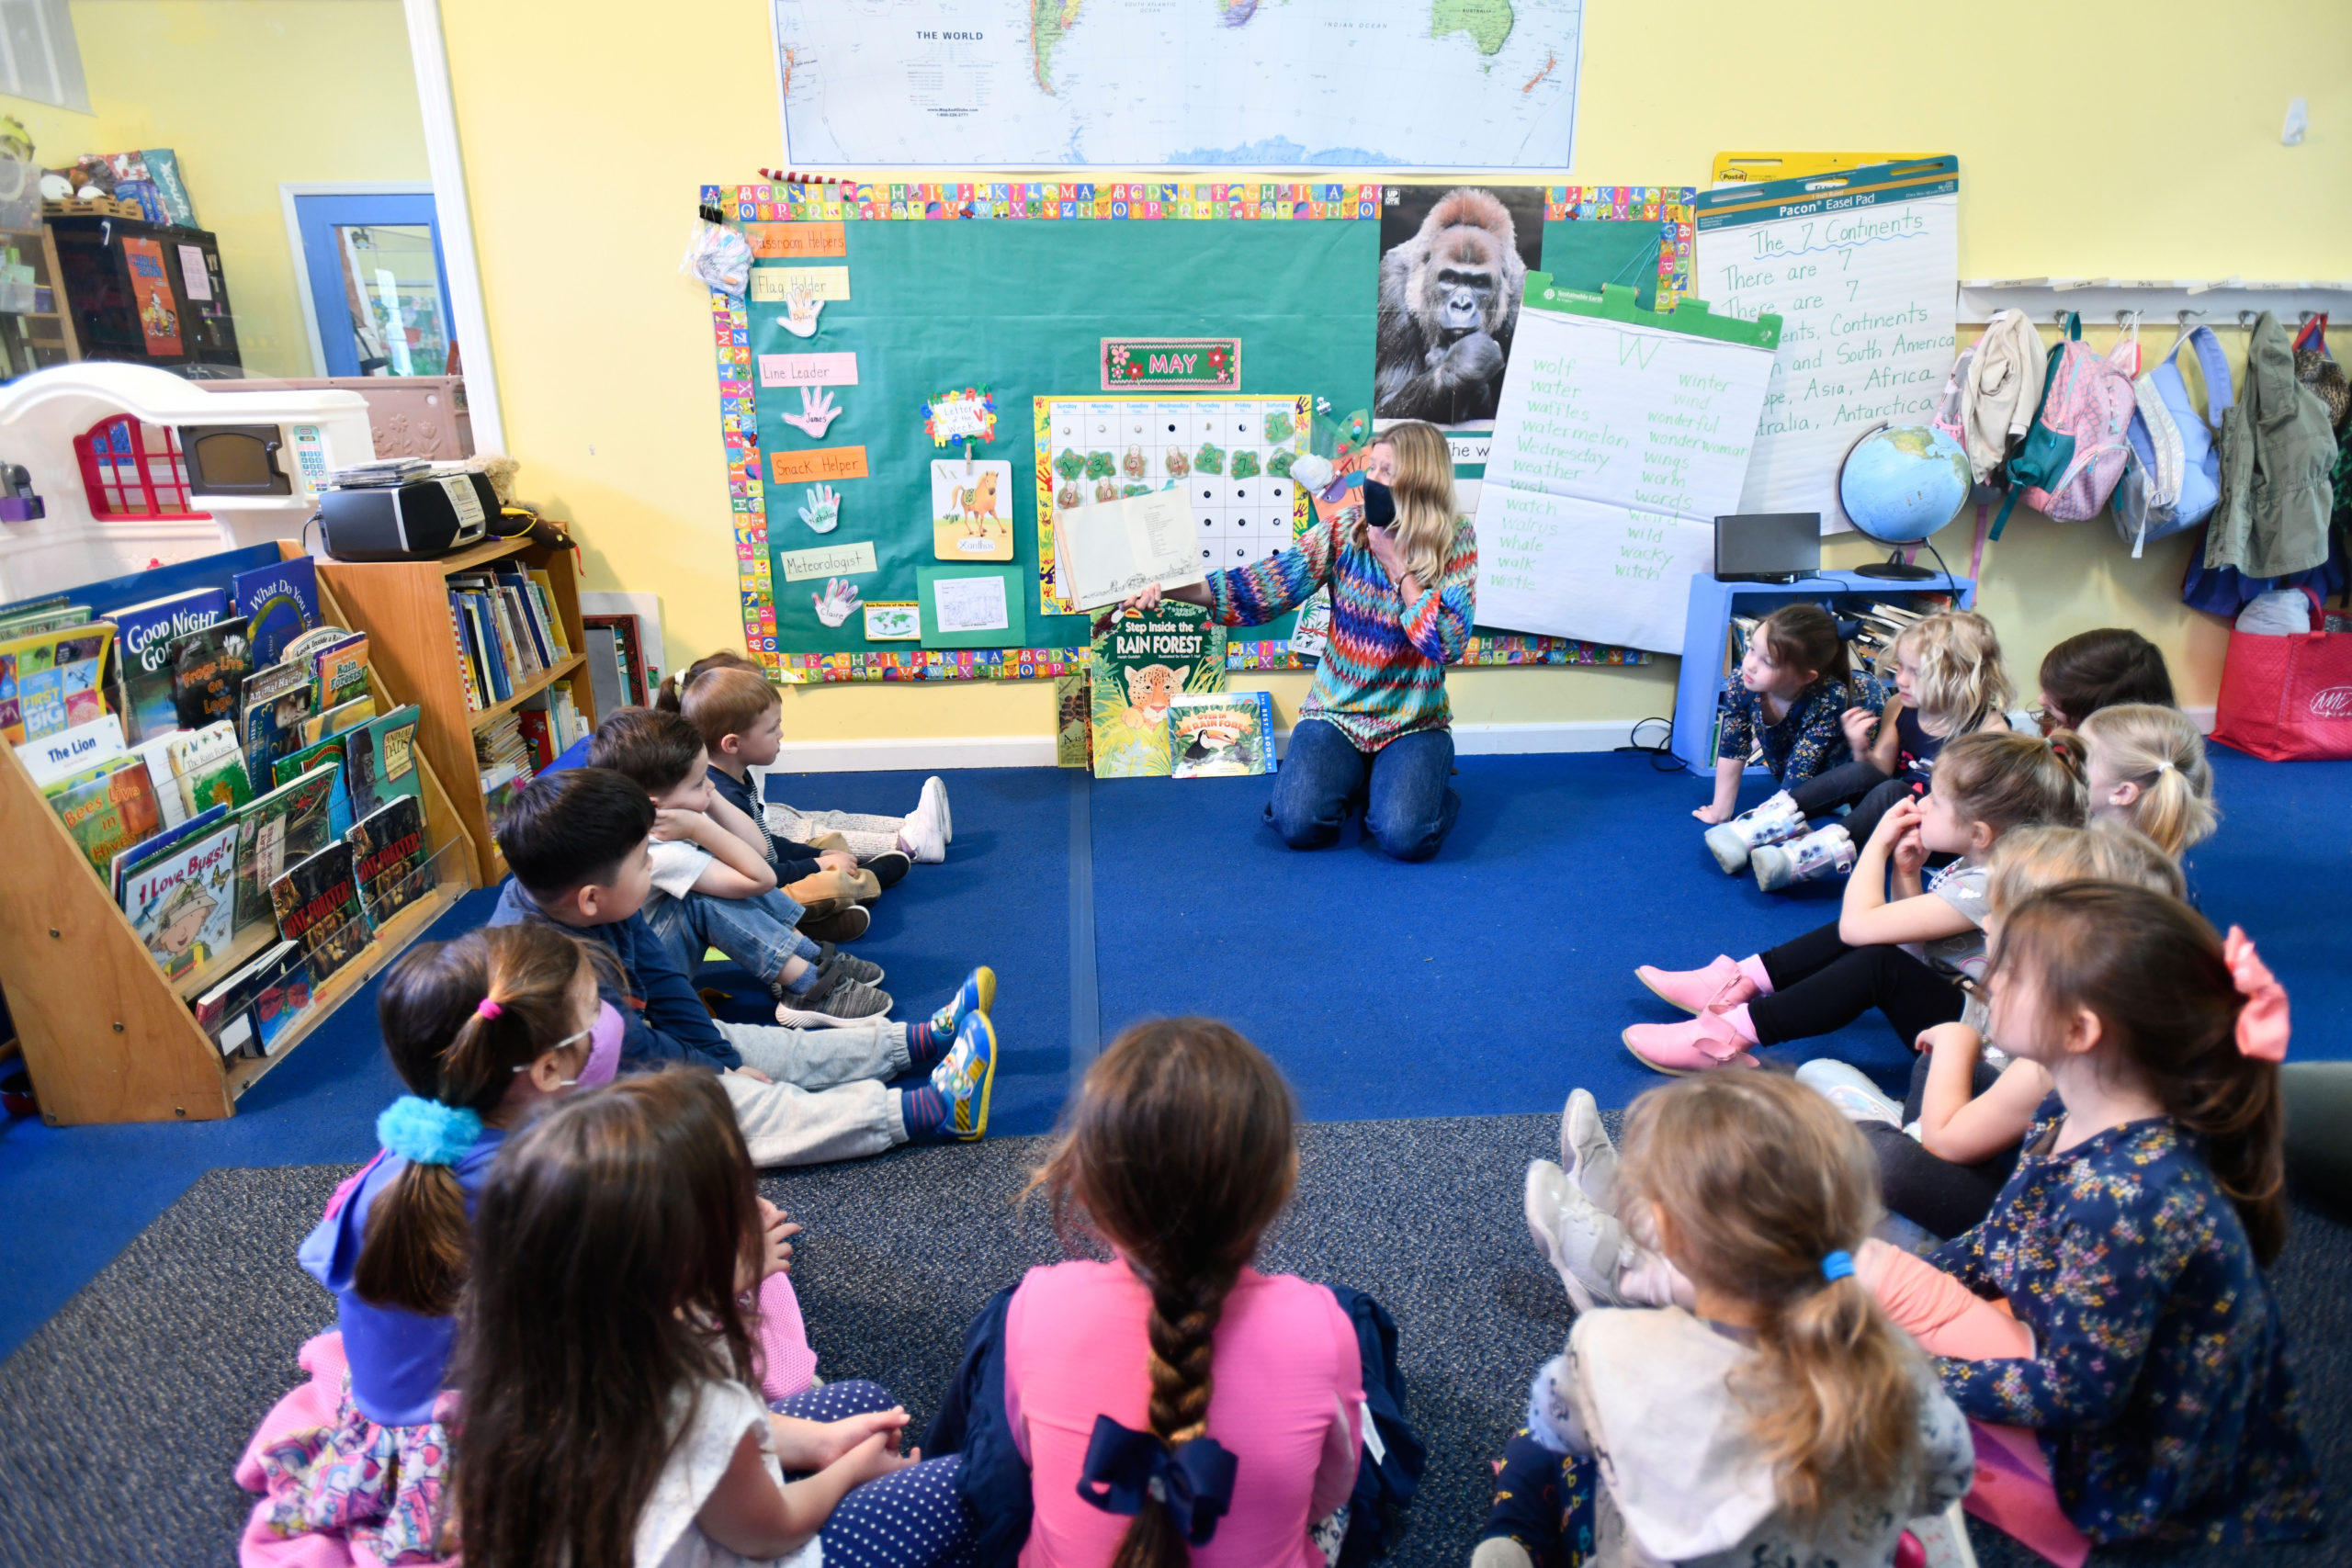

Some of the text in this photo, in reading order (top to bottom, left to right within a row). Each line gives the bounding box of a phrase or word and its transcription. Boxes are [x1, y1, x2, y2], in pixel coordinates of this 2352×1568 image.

[916, 31, 984, 40] THE WORLD
[1826, 196, 1854, 210] Easel
[1856, 194, 1874, 206] Pad
[1749, 207, 1923, 254] The 7 Continents
[808, 231, 844, 252] Helpers
[1720, 249, 1852, 290] There are 7
[758, 276, 785, 299] Flag
[1589, 294, 1603, 303] Earth
[1722, 281, 1859, 320] There are 7
[1830, 301, 1928, 336] Continents
[1620, 332, 1662, 370] W
[1792, 349, 1823, 371] and
[1838, 341, 1882, 366] South
[1892, 333, 1955, 356] America
[763, 362, 830, 379] Line Leader
[1149, 354, 1197, 374] MAY
[1533, 357, 1577, 377] wolf
[1531, 379, 1581, 399] water
[1679, 373, 1733, 392] winter
[1804, 378, 1853, 400] Asia,
[1863, 368, 1935, 391] Africa
[806, 412, 827, 423] James
[1527, 399, 1590, 422] waffles
[1833, 395, 1934, 426] Antarctica
[1647, 411, 1720, 434] wonderful
[1522, 420, 1629, 449] watermelon
[1448, 442, 1470, 457] he
[1518, 437, 1610, 475] Wednesday
[776, 457, 859, 477] Snack Helper
[1094, 459, 1102, 471] 3
[1173, 457, 1181, 468] 4
[1204, 452, 1213, 463] 6
[1240, 458, 1248, 472] 7
[1276, 459, 1285, 469] 8
[1513, 459, 1585, 480] weather
[1642, 470, 1686, 488] worm
[1507, 498, 1558, 515] watch
[1635, 488, 1693, 510] words
[1500, 536, 1544, 552] whale
[1628, 526, 1664, 544] wild
[787, 551, 862, 574] Meteorologist
[1498, 555, 1537, 572] walk
[1621, 545, 1674, 570] wacky
[1615, 563, 1660, 581] witch
[250, 579, 305, 611] What Do You
[820, 608, 844, 620] Claire
[128, 621, 170, 653] GOOD
[1125, 621, 1194, 634] Step Inside the
[311, 637, 327, 647] Inside
[1117, 636, 1203, 654] RAIN FOREST
[183, 655, 243, 688] Frogs Live
[336, 660, 357, 674] Rain
[208, 679, 224, 693] on
[330, 669, 363, 689] Forests
[23, 687, 61, 709] FIRST
[204, 694, 232, 714] Logs
[261, 703, 274, 717] 3
[1191, 718, 1217, 731] RAIN
[48, 745, 71, 763] The
[72, 737, 96, 754] Lion
[63, 784, 141, 829] Bees Live
[101, 815, 117, 831] in
[92, 833, 136, 863] Hives
[140, 837, 227, 905] I Love Bugs!
